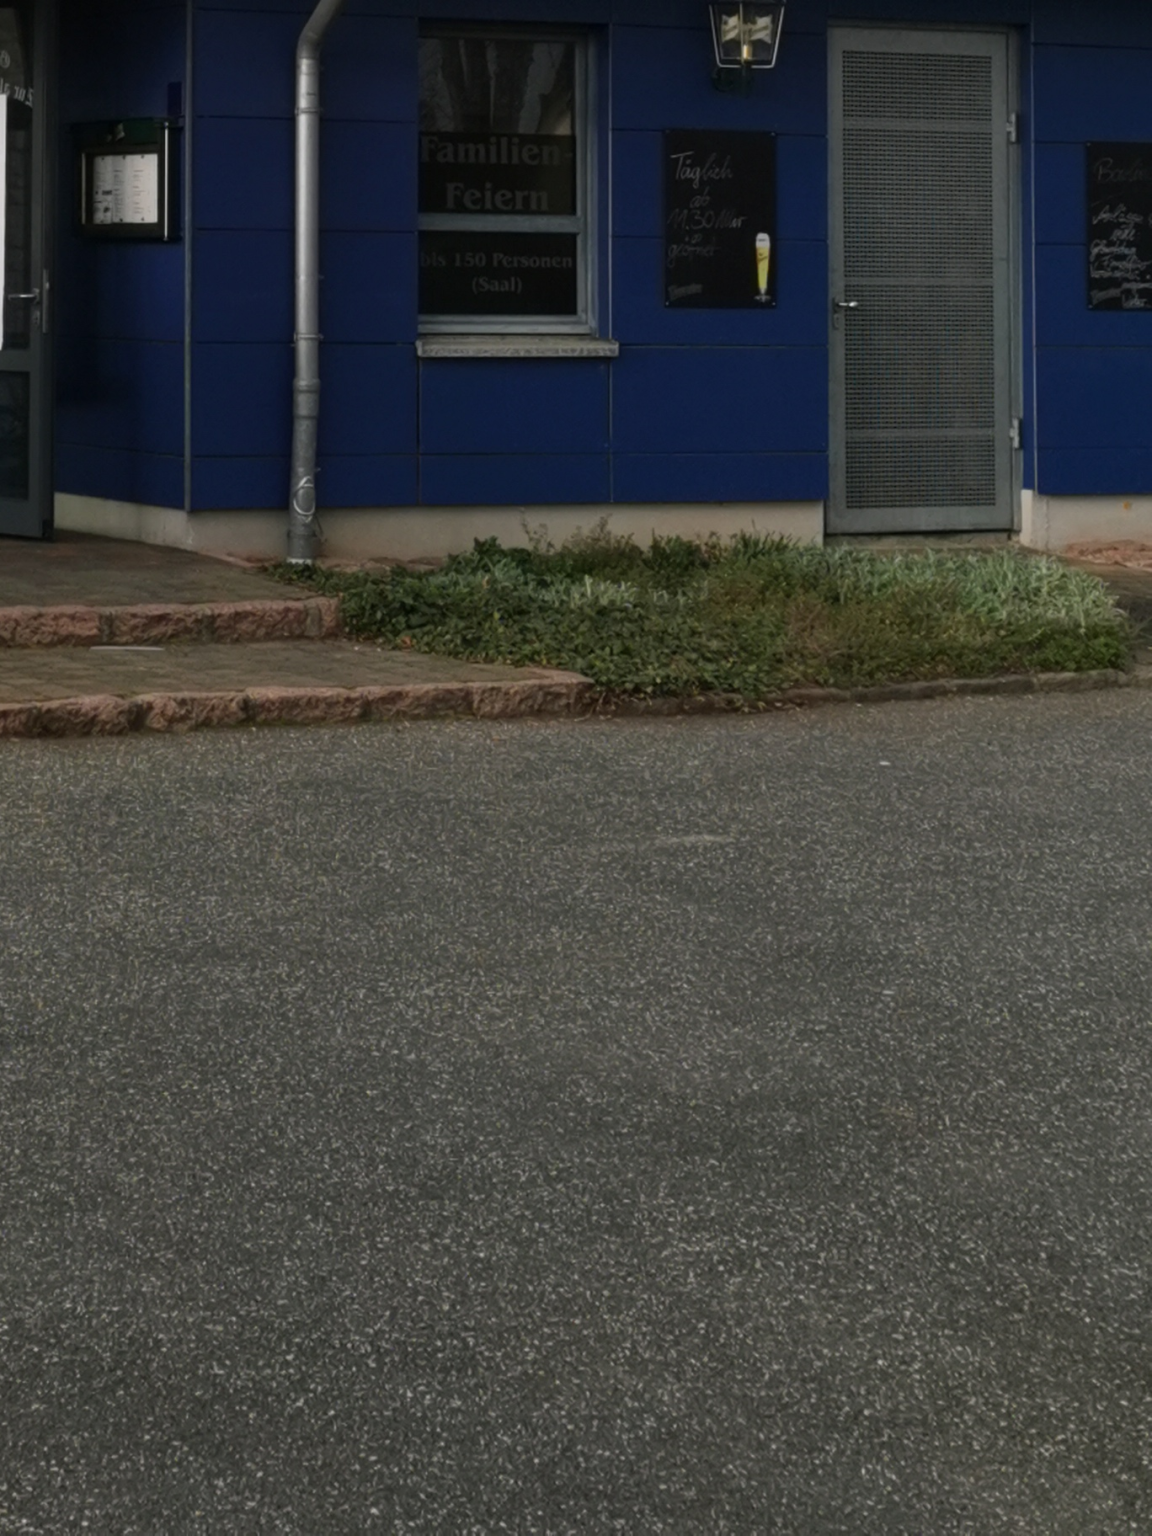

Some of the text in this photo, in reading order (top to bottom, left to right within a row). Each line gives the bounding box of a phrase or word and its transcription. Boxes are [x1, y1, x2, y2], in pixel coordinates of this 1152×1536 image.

[420, 135, 573, 166] Familien-
[445, 181, 550, 211] Feiern
[689, 186, 711, 209] ab
[421, 252, 573, 269] bis 150 Personen
[471, 276, 522, 295] (Saal)
